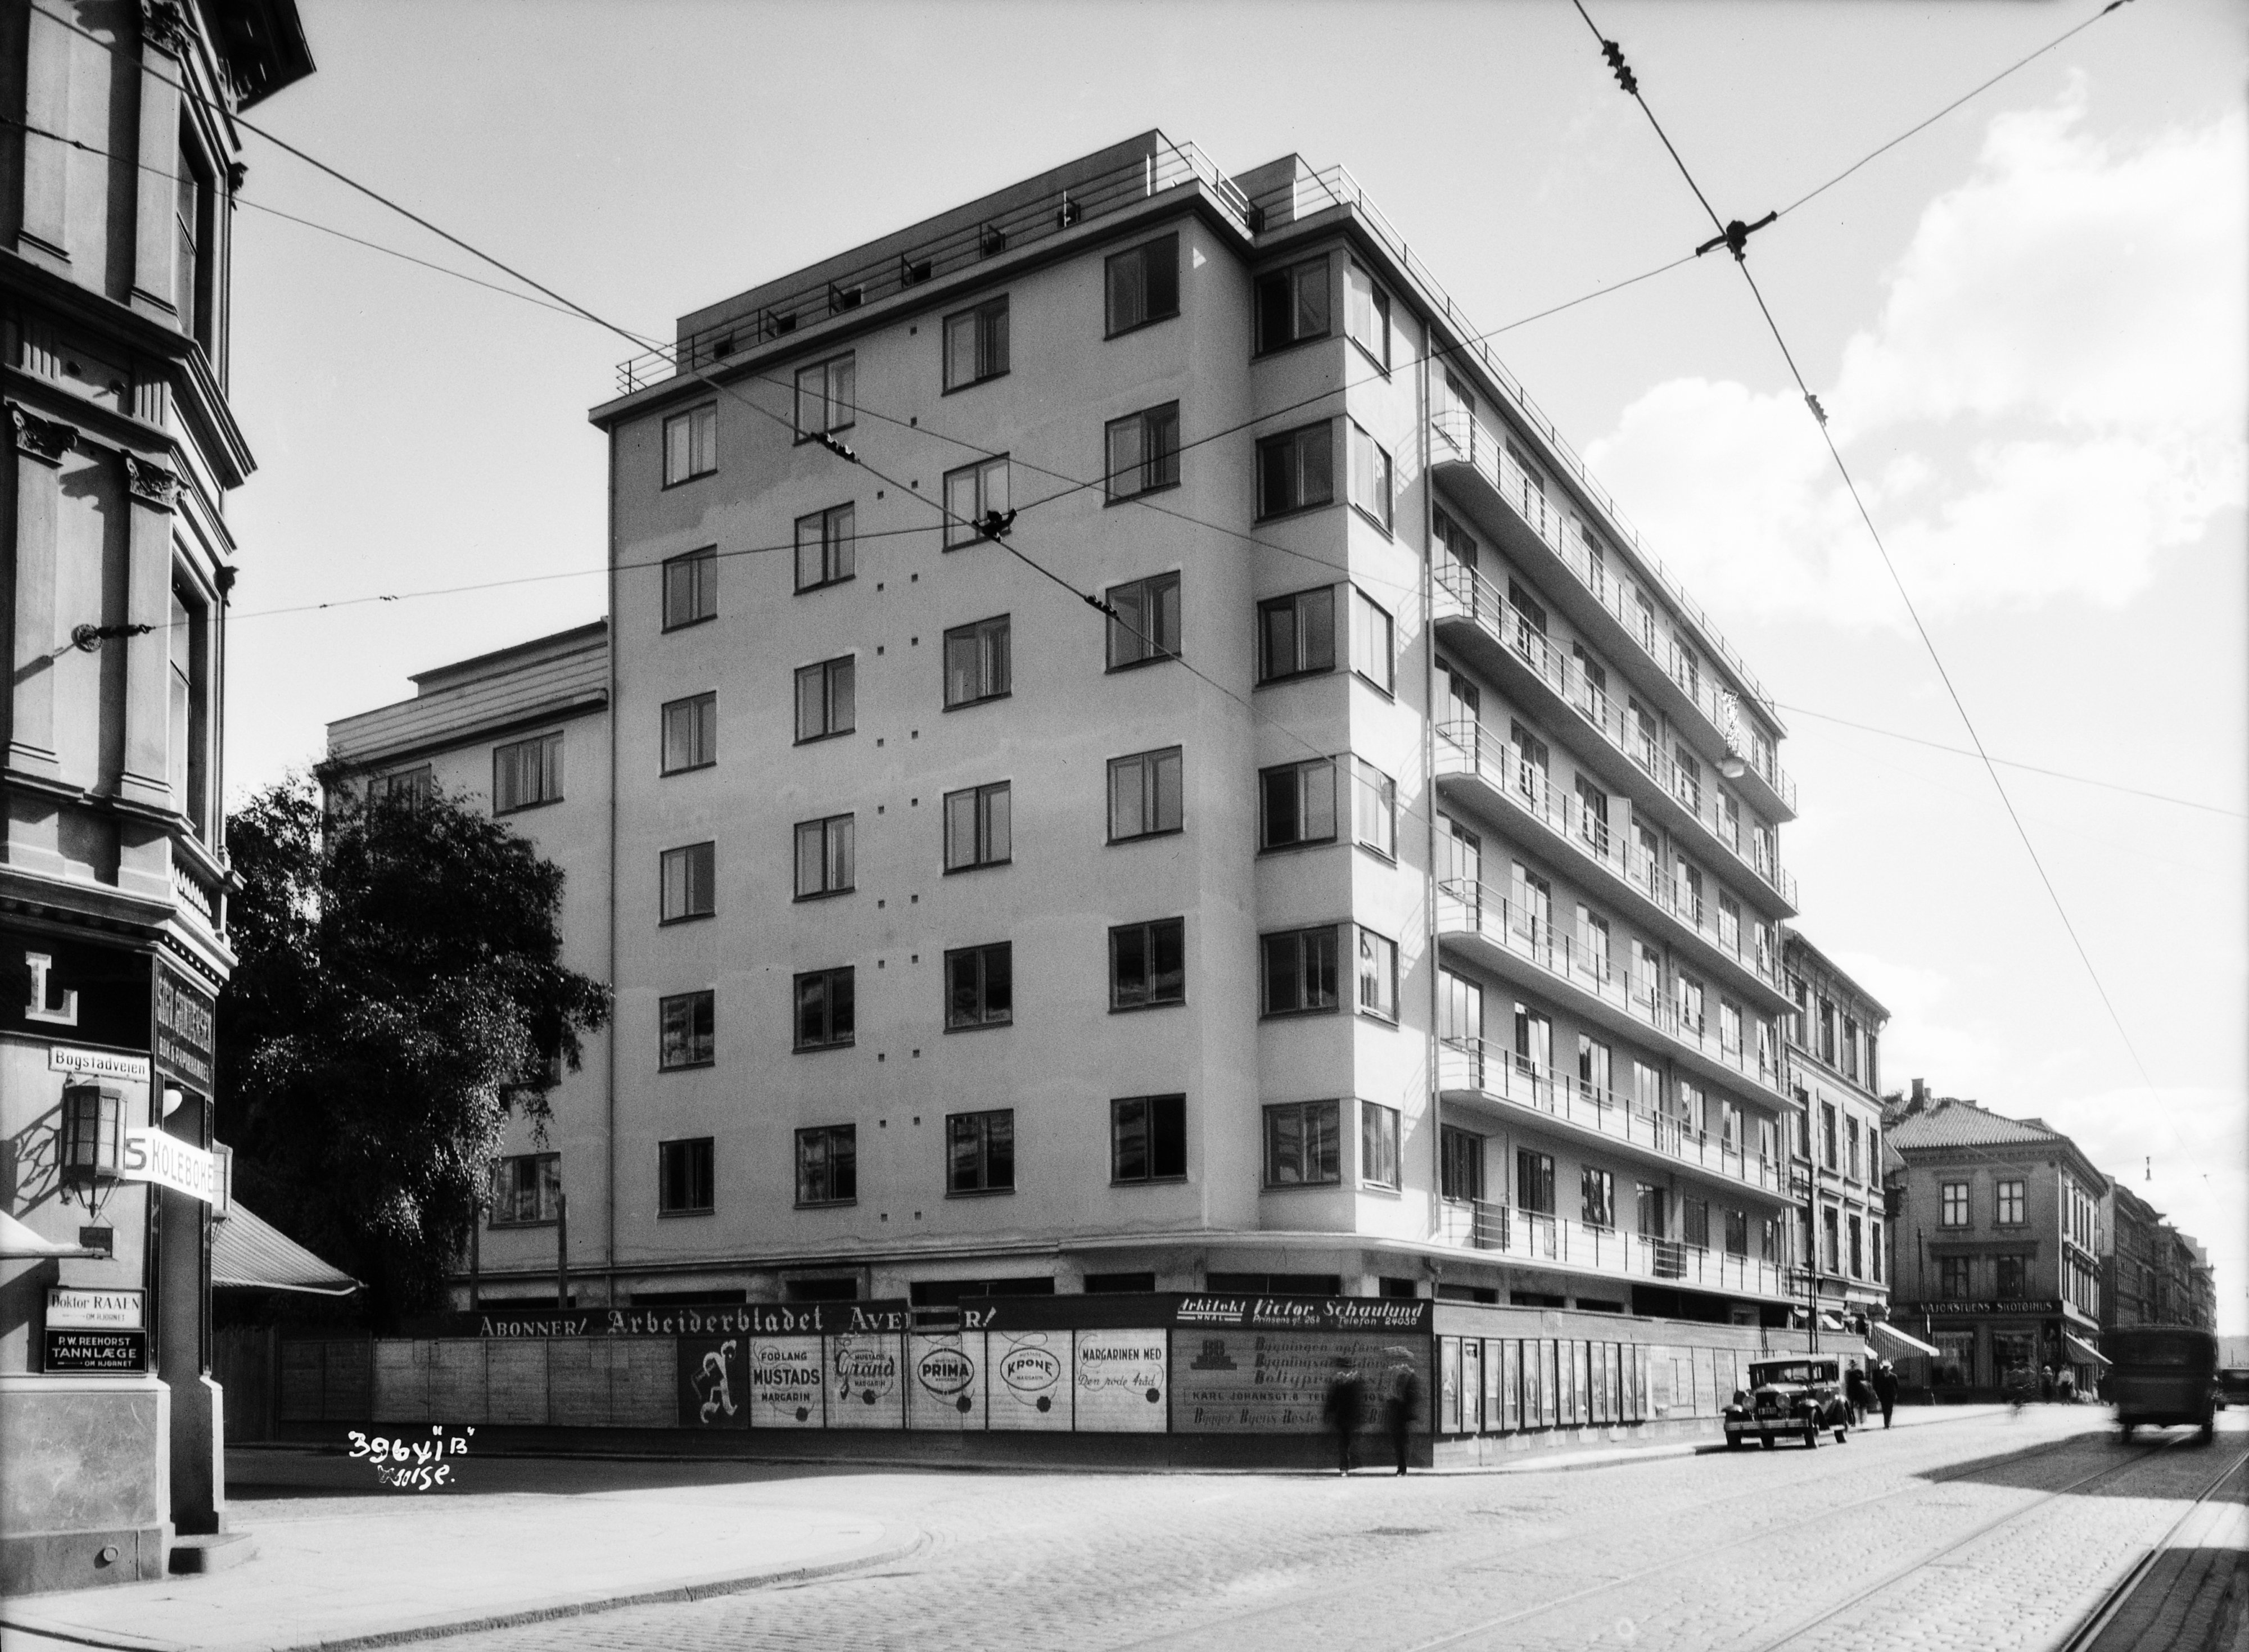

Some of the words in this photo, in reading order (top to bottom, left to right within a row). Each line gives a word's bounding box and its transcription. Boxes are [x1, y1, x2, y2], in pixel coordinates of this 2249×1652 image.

[25, 951, 78, 1026] L
[56, 1051, 145, 1075] Bogstadveien
[52, 1294, 89, 1309] Doktor
[94, 1296, 139, 1310] RAAEN
[1253, 1298, 1314, 1316] Victor
[608, 1305, 824, 1335] Arbeiderbladet
[1338, 1315, 1376, 1327] Telefon
[58, 1336, 65, 1346] P.
[67, 1337, 76, 1346] W.
[79, 1337, 130, 1346] REEHORST
[52, 1347, 137, 1359] TANNLÆGE
[761, 1352, 807, 1361] FORLANG
[1083, 1348, 1140, 1361] MARGARINEN
[1144, 1348, 1162, 1360] MED
[922, 1364, 969, 1377] PRIMA
[1008, 1359, 1053, 1377] KRONE
[754, 1369, 820, 1385] MUSTADS
[761, 1393, 810, 1402] MARGARIN
[1193, 1391, 1222, 1401] KARL
